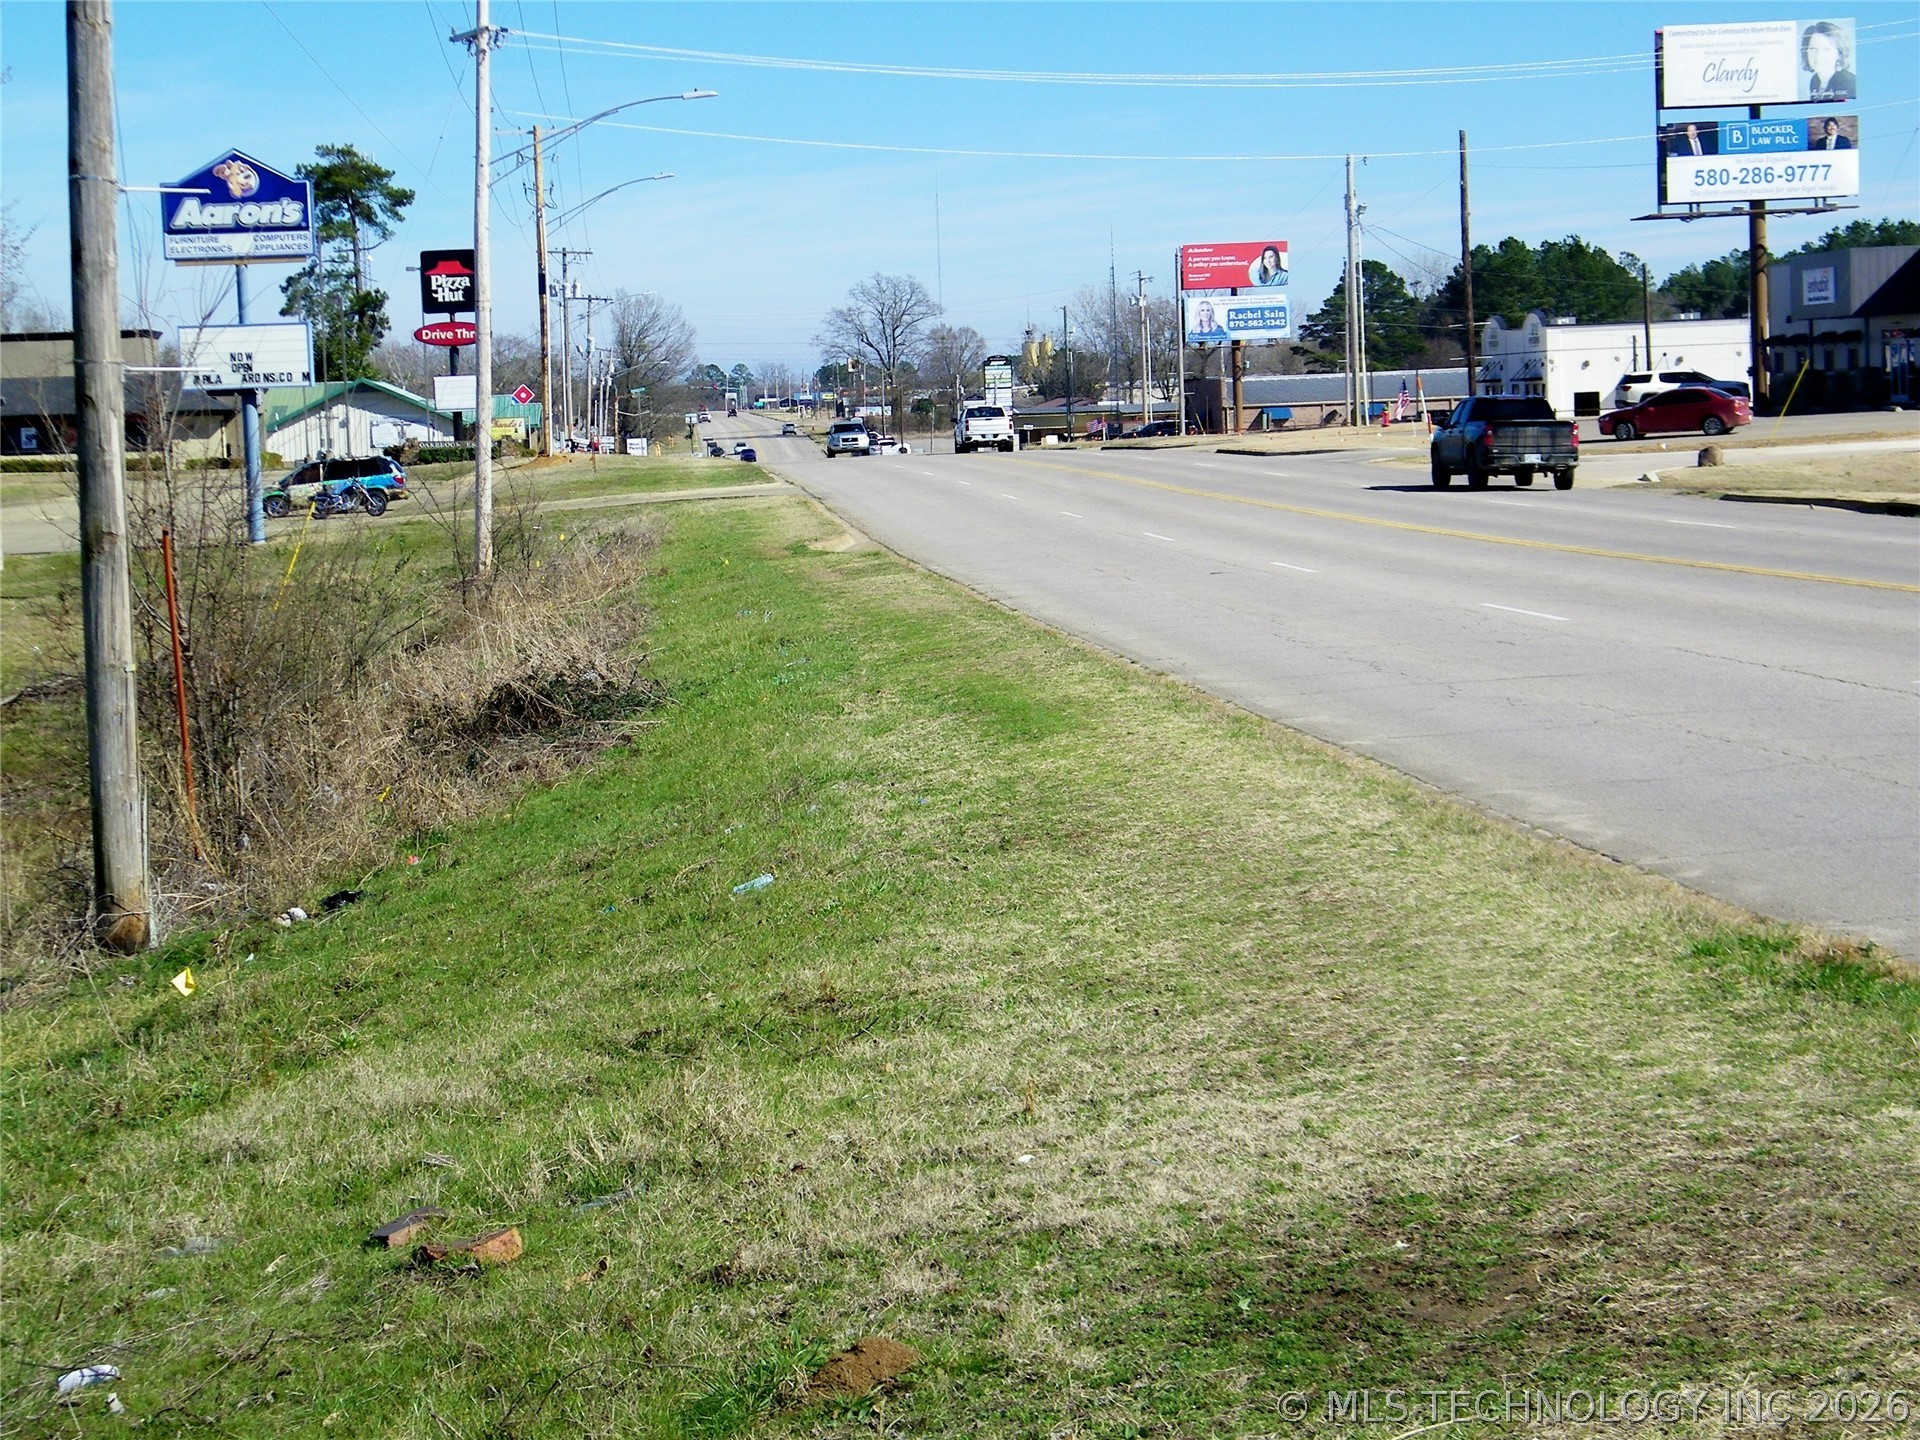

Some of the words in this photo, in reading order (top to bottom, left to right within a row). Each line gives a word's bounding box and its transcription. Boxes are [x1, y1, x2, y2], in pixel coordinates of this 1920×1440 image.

[1702, 57, 1759, 93] Clardy
[1751, 124, 1796, 136] BLOCKER
[1732, 129, 1744, 144] B
[1751, 137, 1771, 146] LAW
[1775, 135, 1799, 145] PLLC
[1694, 164, 1832, 187] 580-286-9777
[170, 197, 304, 229] Aaron's
[169, 235, 220, 244] FURNITURE
[253, 233, 309, 242] COMPUTERS
[169, 245, 233, 254] ELECTRONICS
[253, 242, 309, 251] APPLIANCES
[430, 274, 471, 290] Pizza
[431, 286, 465, 302] Hut
[1228, 310, 1261, 320] Rachel
[1264, 309, 1285, 318] Sain
[1229, 319, 1286, 328] 870-562-1342
[421, 329, 454, 340] Drive
[455, 327, 476, 339] Thr
[229, 352, 253, 361] NOW
[231, 363, 253, 373] OPEN
